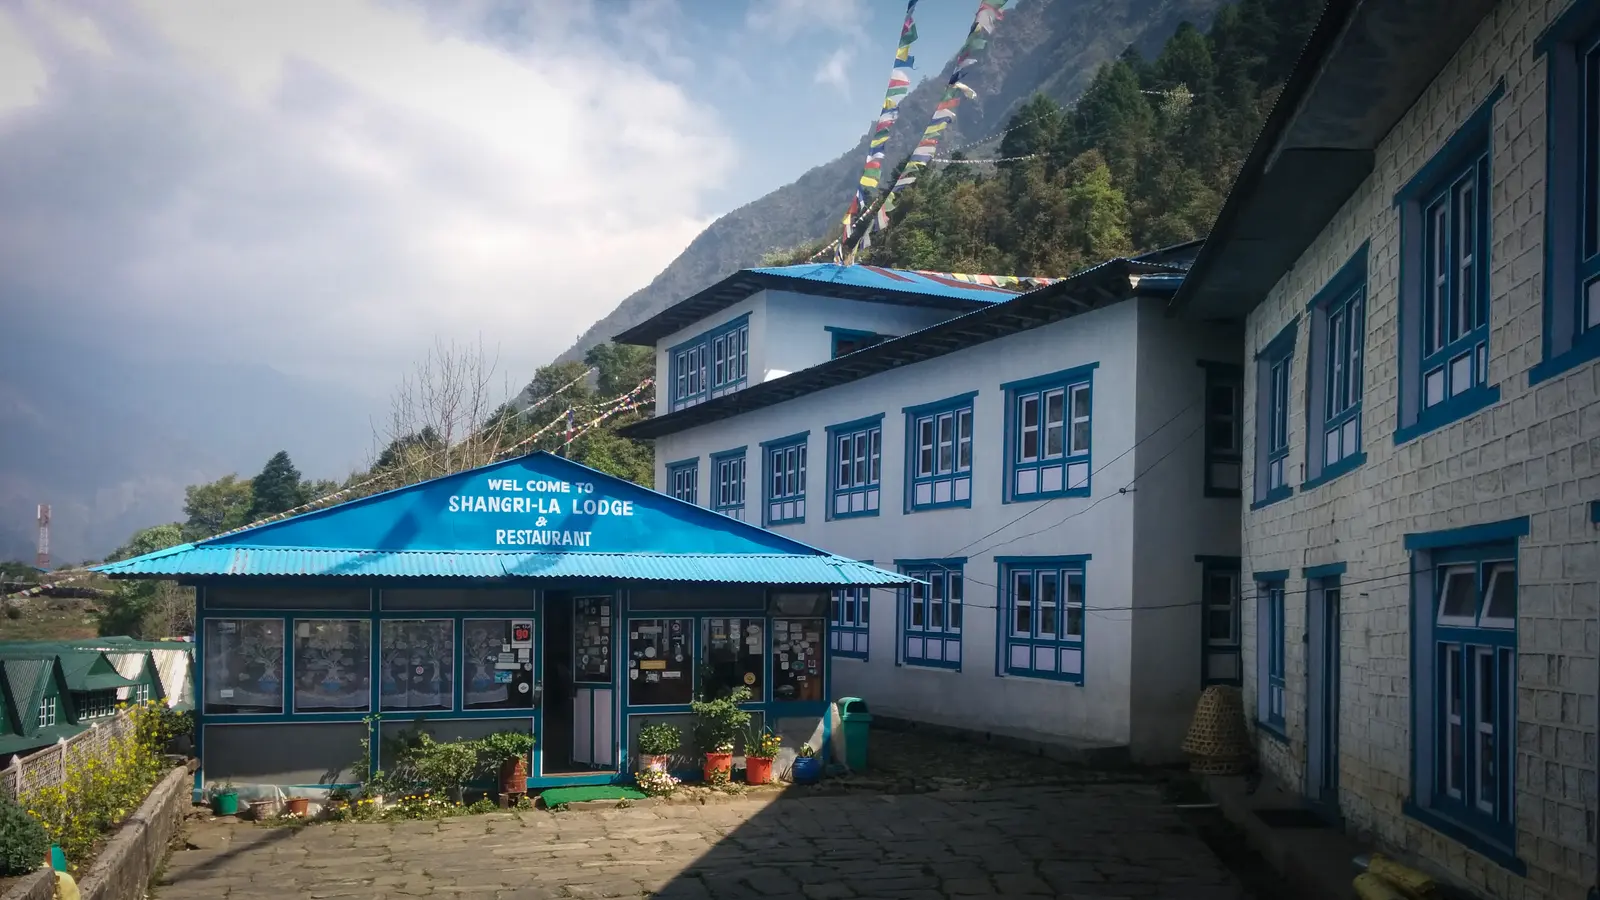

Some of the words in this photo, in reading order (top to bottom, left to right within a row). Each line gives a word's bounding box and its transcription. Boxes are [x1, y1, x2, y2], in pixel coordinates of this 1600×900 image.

[575, 482, 594, 494] TO
[449, 495, 561, 514] SHANGRI-LA
[572, 499, 633, 516] LODGE
[535, 516, 548, 527] &
[496, 529, 592, 547] RESTAURANT
